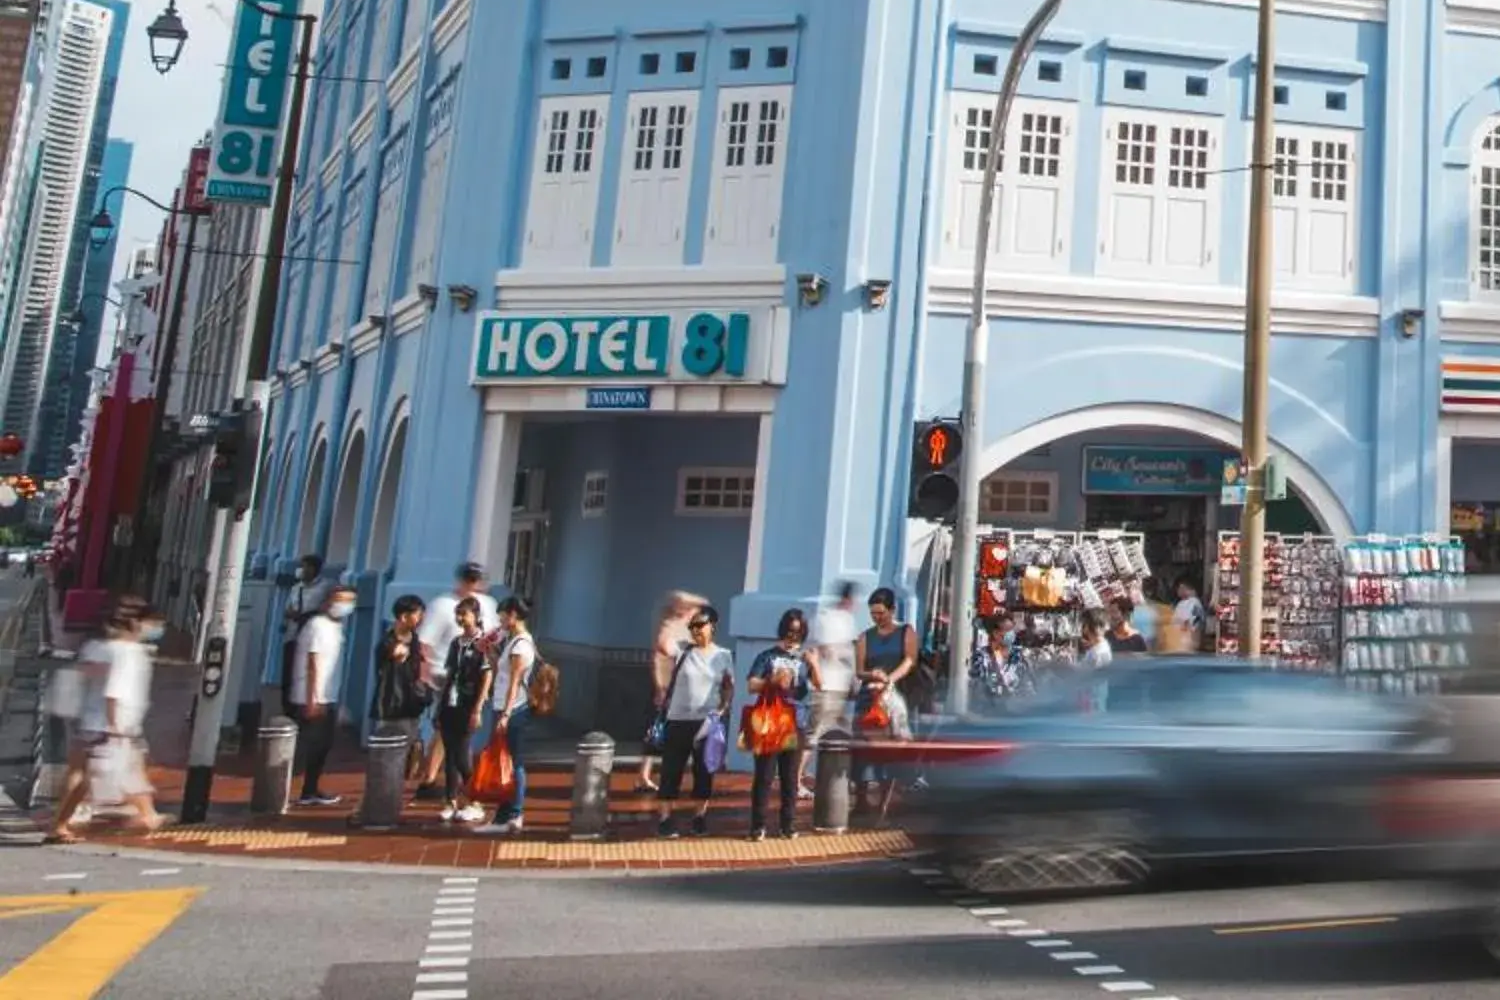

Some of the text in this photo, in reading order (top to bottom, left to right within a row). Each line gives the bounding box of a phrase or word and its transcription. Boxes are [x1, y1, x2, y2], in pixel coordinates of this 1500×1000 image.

[217, 131, 274, 177] 81
[487, 312, 750, 378] HOTEL 81
